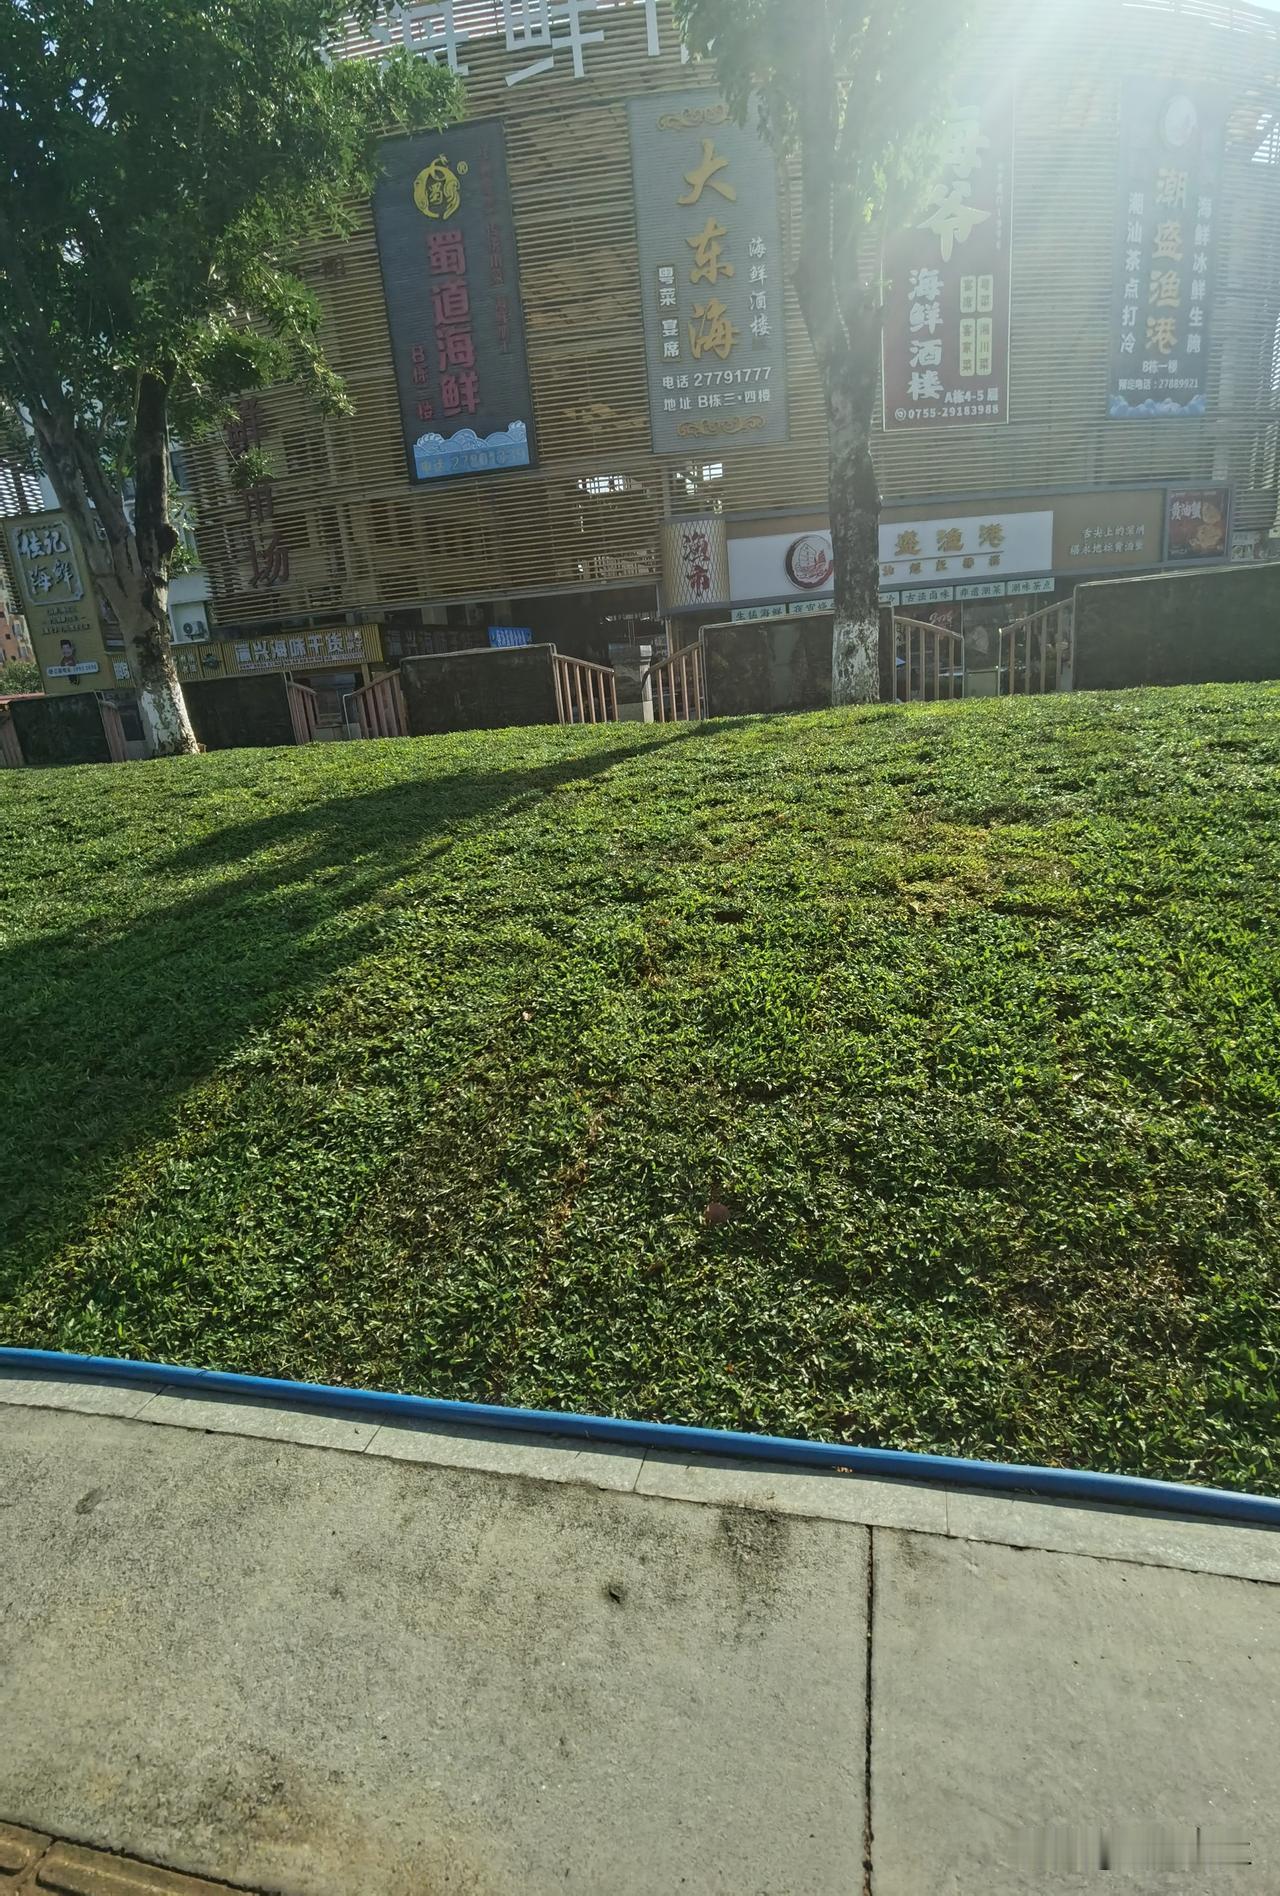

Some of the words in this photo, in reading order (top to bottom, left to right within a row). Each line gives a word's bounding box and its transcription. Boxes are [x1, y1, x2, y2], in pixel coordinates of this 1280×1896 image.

[658, 266, 677, 307] 粤菜
[676, 138, 741, 360] 大东海
[747, 236, 773, 337] 海鲜酒楼
[1145, 167, 1188, 355] 潮盛渔港
[424, 229, 480, 418] 蜀道海鲜
[661, 318, 681, 358] 宴席
[906, 267, 945, 401] 海鲜酒楼
[661, 374, 690, 390] 电话
[693, 365, 772, 388] 27791777
[663, 397, 692, 412] 地址
